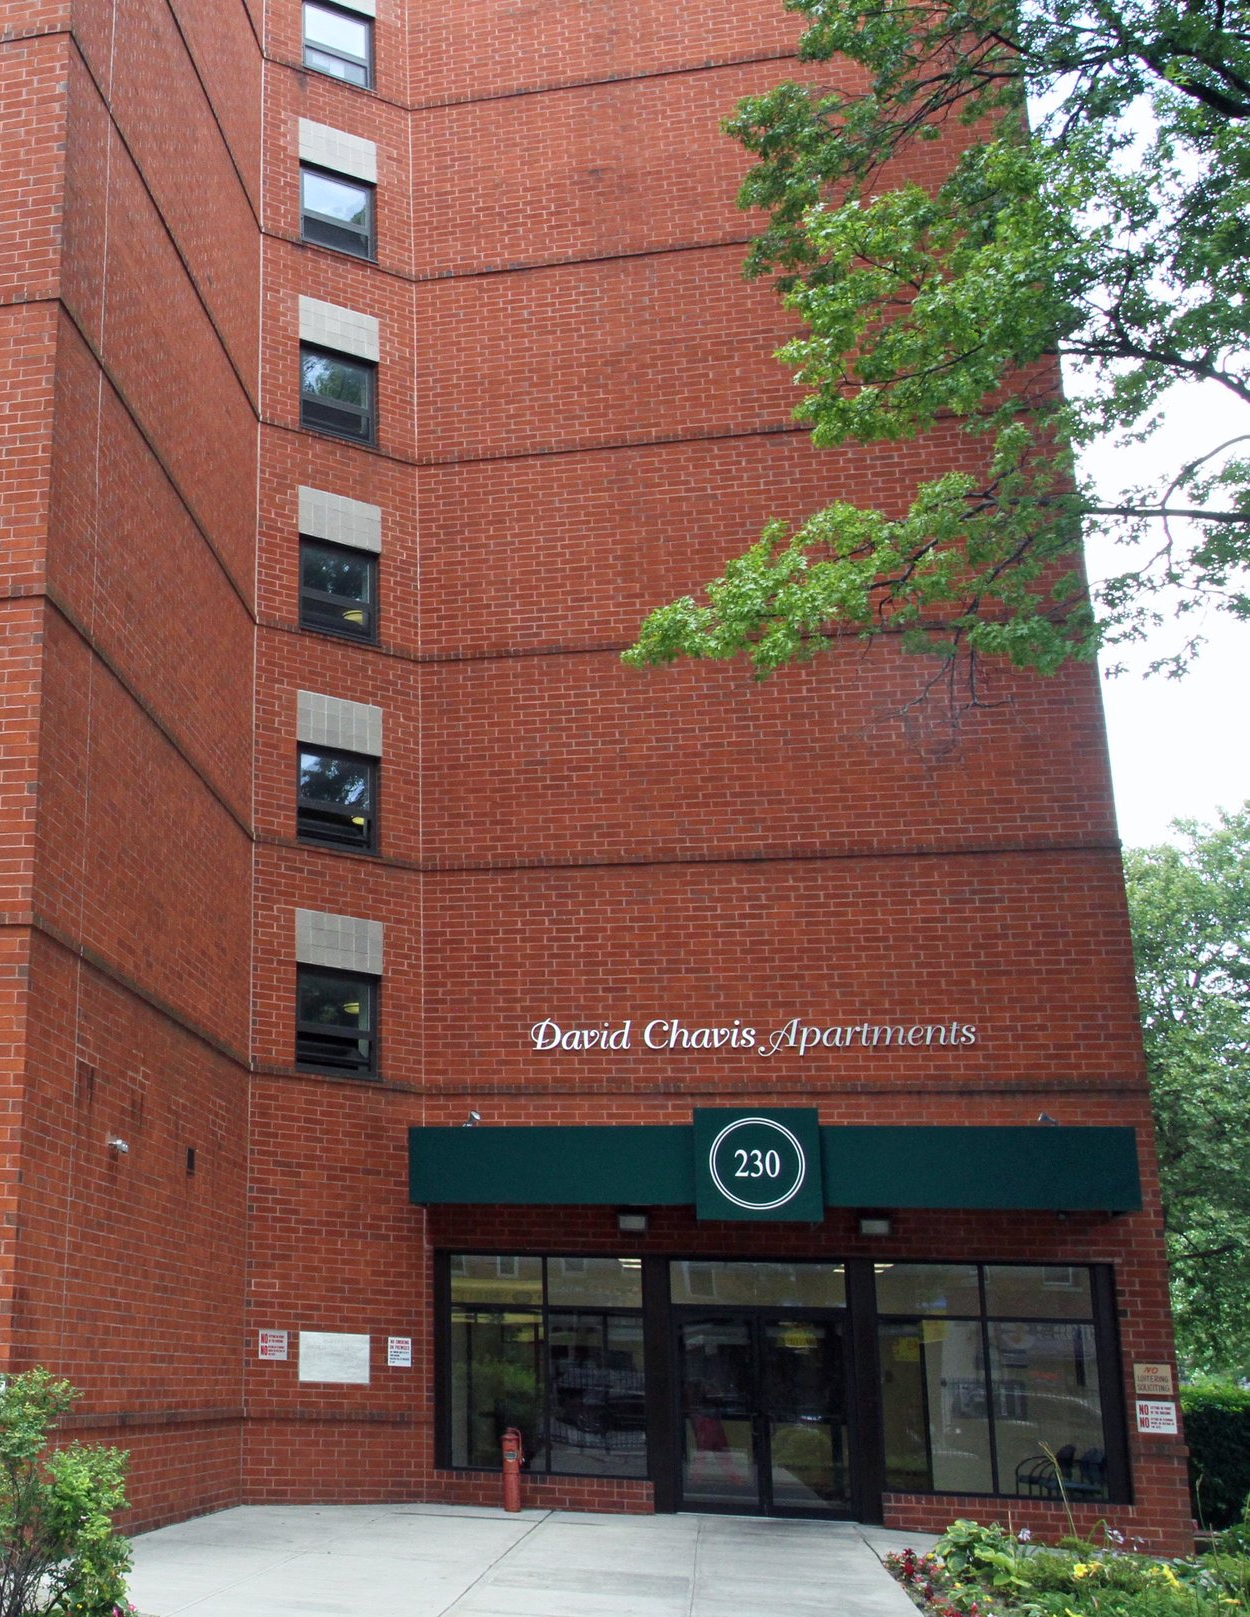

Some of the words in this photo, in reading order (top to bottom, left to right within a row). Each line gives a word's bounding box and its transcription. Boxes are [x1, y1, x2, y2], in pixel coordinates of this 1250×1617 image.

[530, 1017, 631, 1050] David
[643, 1018, 756, 1050] Chavis
[758, 1017, 977, 1057] Apartments
[734, 1149, 781, 1178] 230
[1137, 1375, 1169, 1383] LOITERING
[1137, 1384, 1170, 1392] SOLICITING
[1139, 1404, 1149, 1415] NO
[1140, 1417, 1150, 1428] NO
